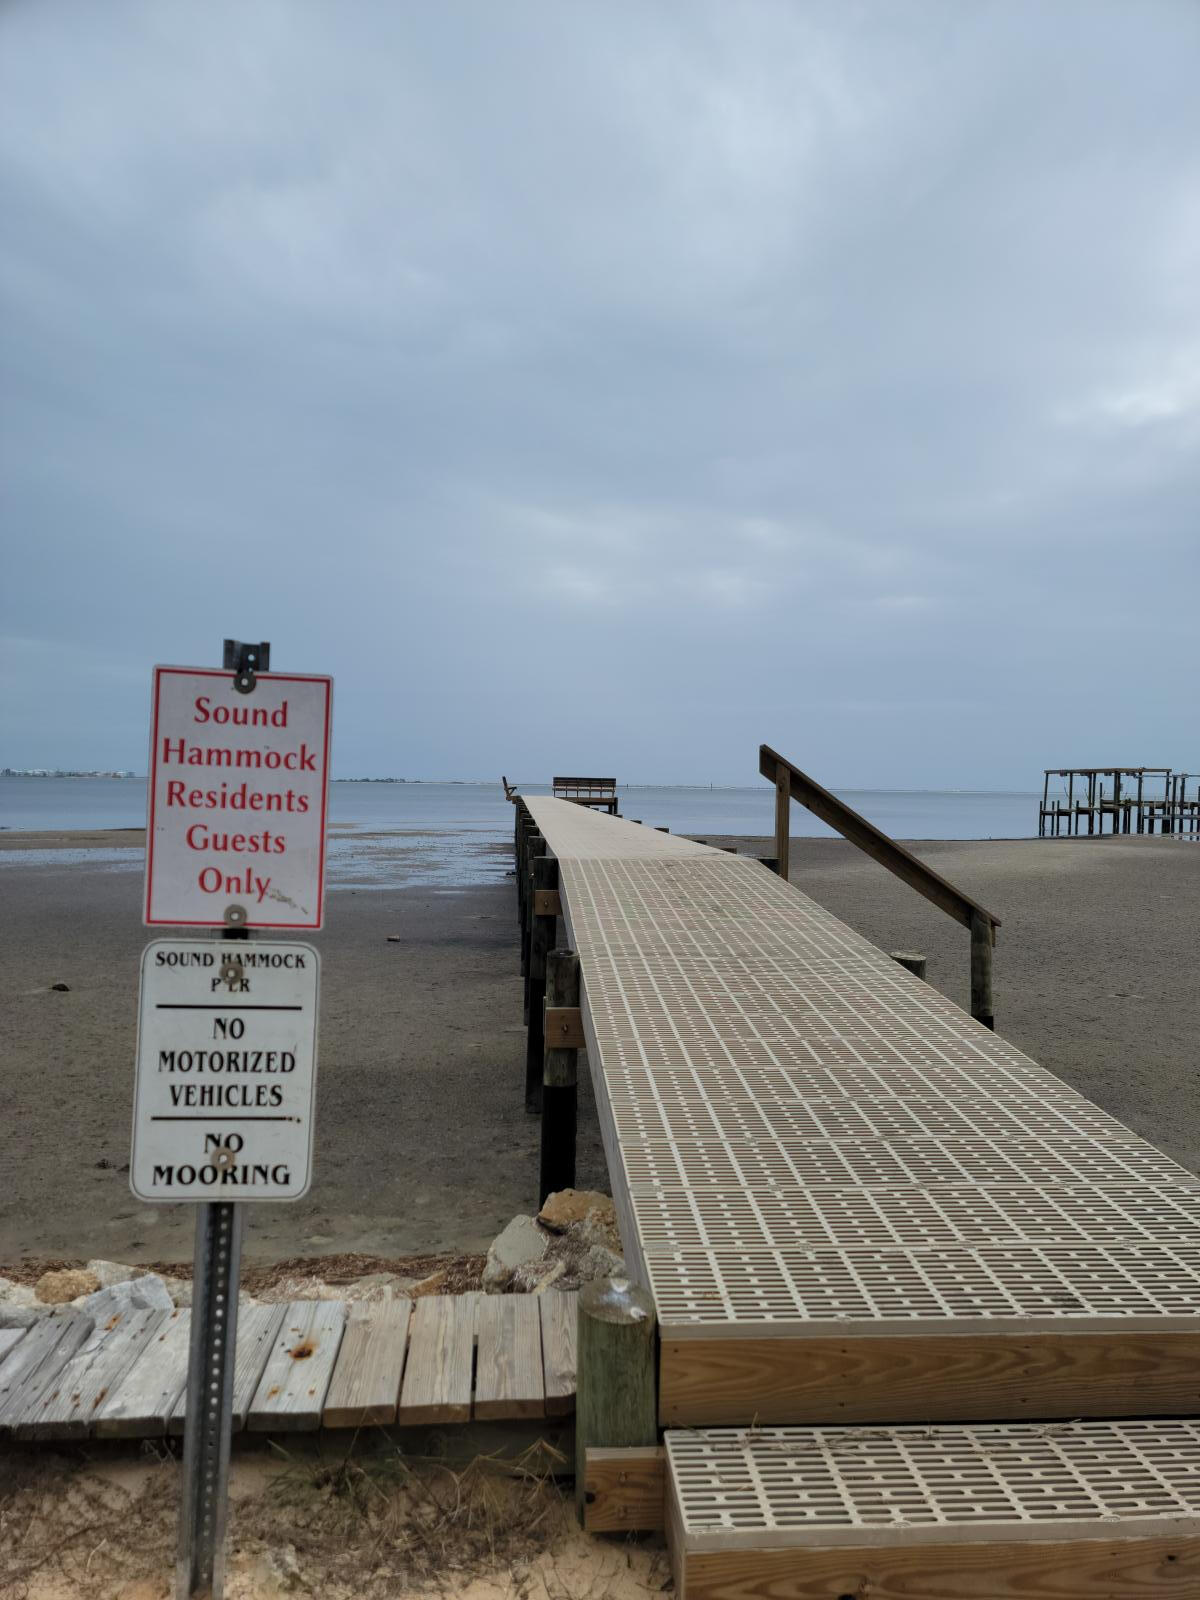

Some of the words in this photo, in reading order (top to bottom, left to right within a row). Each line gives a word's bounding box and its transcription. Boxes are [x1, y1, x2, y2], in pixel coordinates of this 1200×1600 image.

[194, 697, 288, 728] Sound
[162, 738, 316, 771] Hammock
[167, 781, 309, 813] Residents
[186, 824, 285, 854] Guests
[199, 867, 271, 903] Only
[156, 952, 214, 968] SOUND
[221, 953, 306, 968] HAMMOCK
[213, 1018, 245, 1039] NO
[158, 1051, 296, 1072] MOTORIZED
[169, 1085, 283, 1107] VEHICLES
[204, 1133, 244, 1153] NO
[153, 1165, 290, 1186] MOORING
